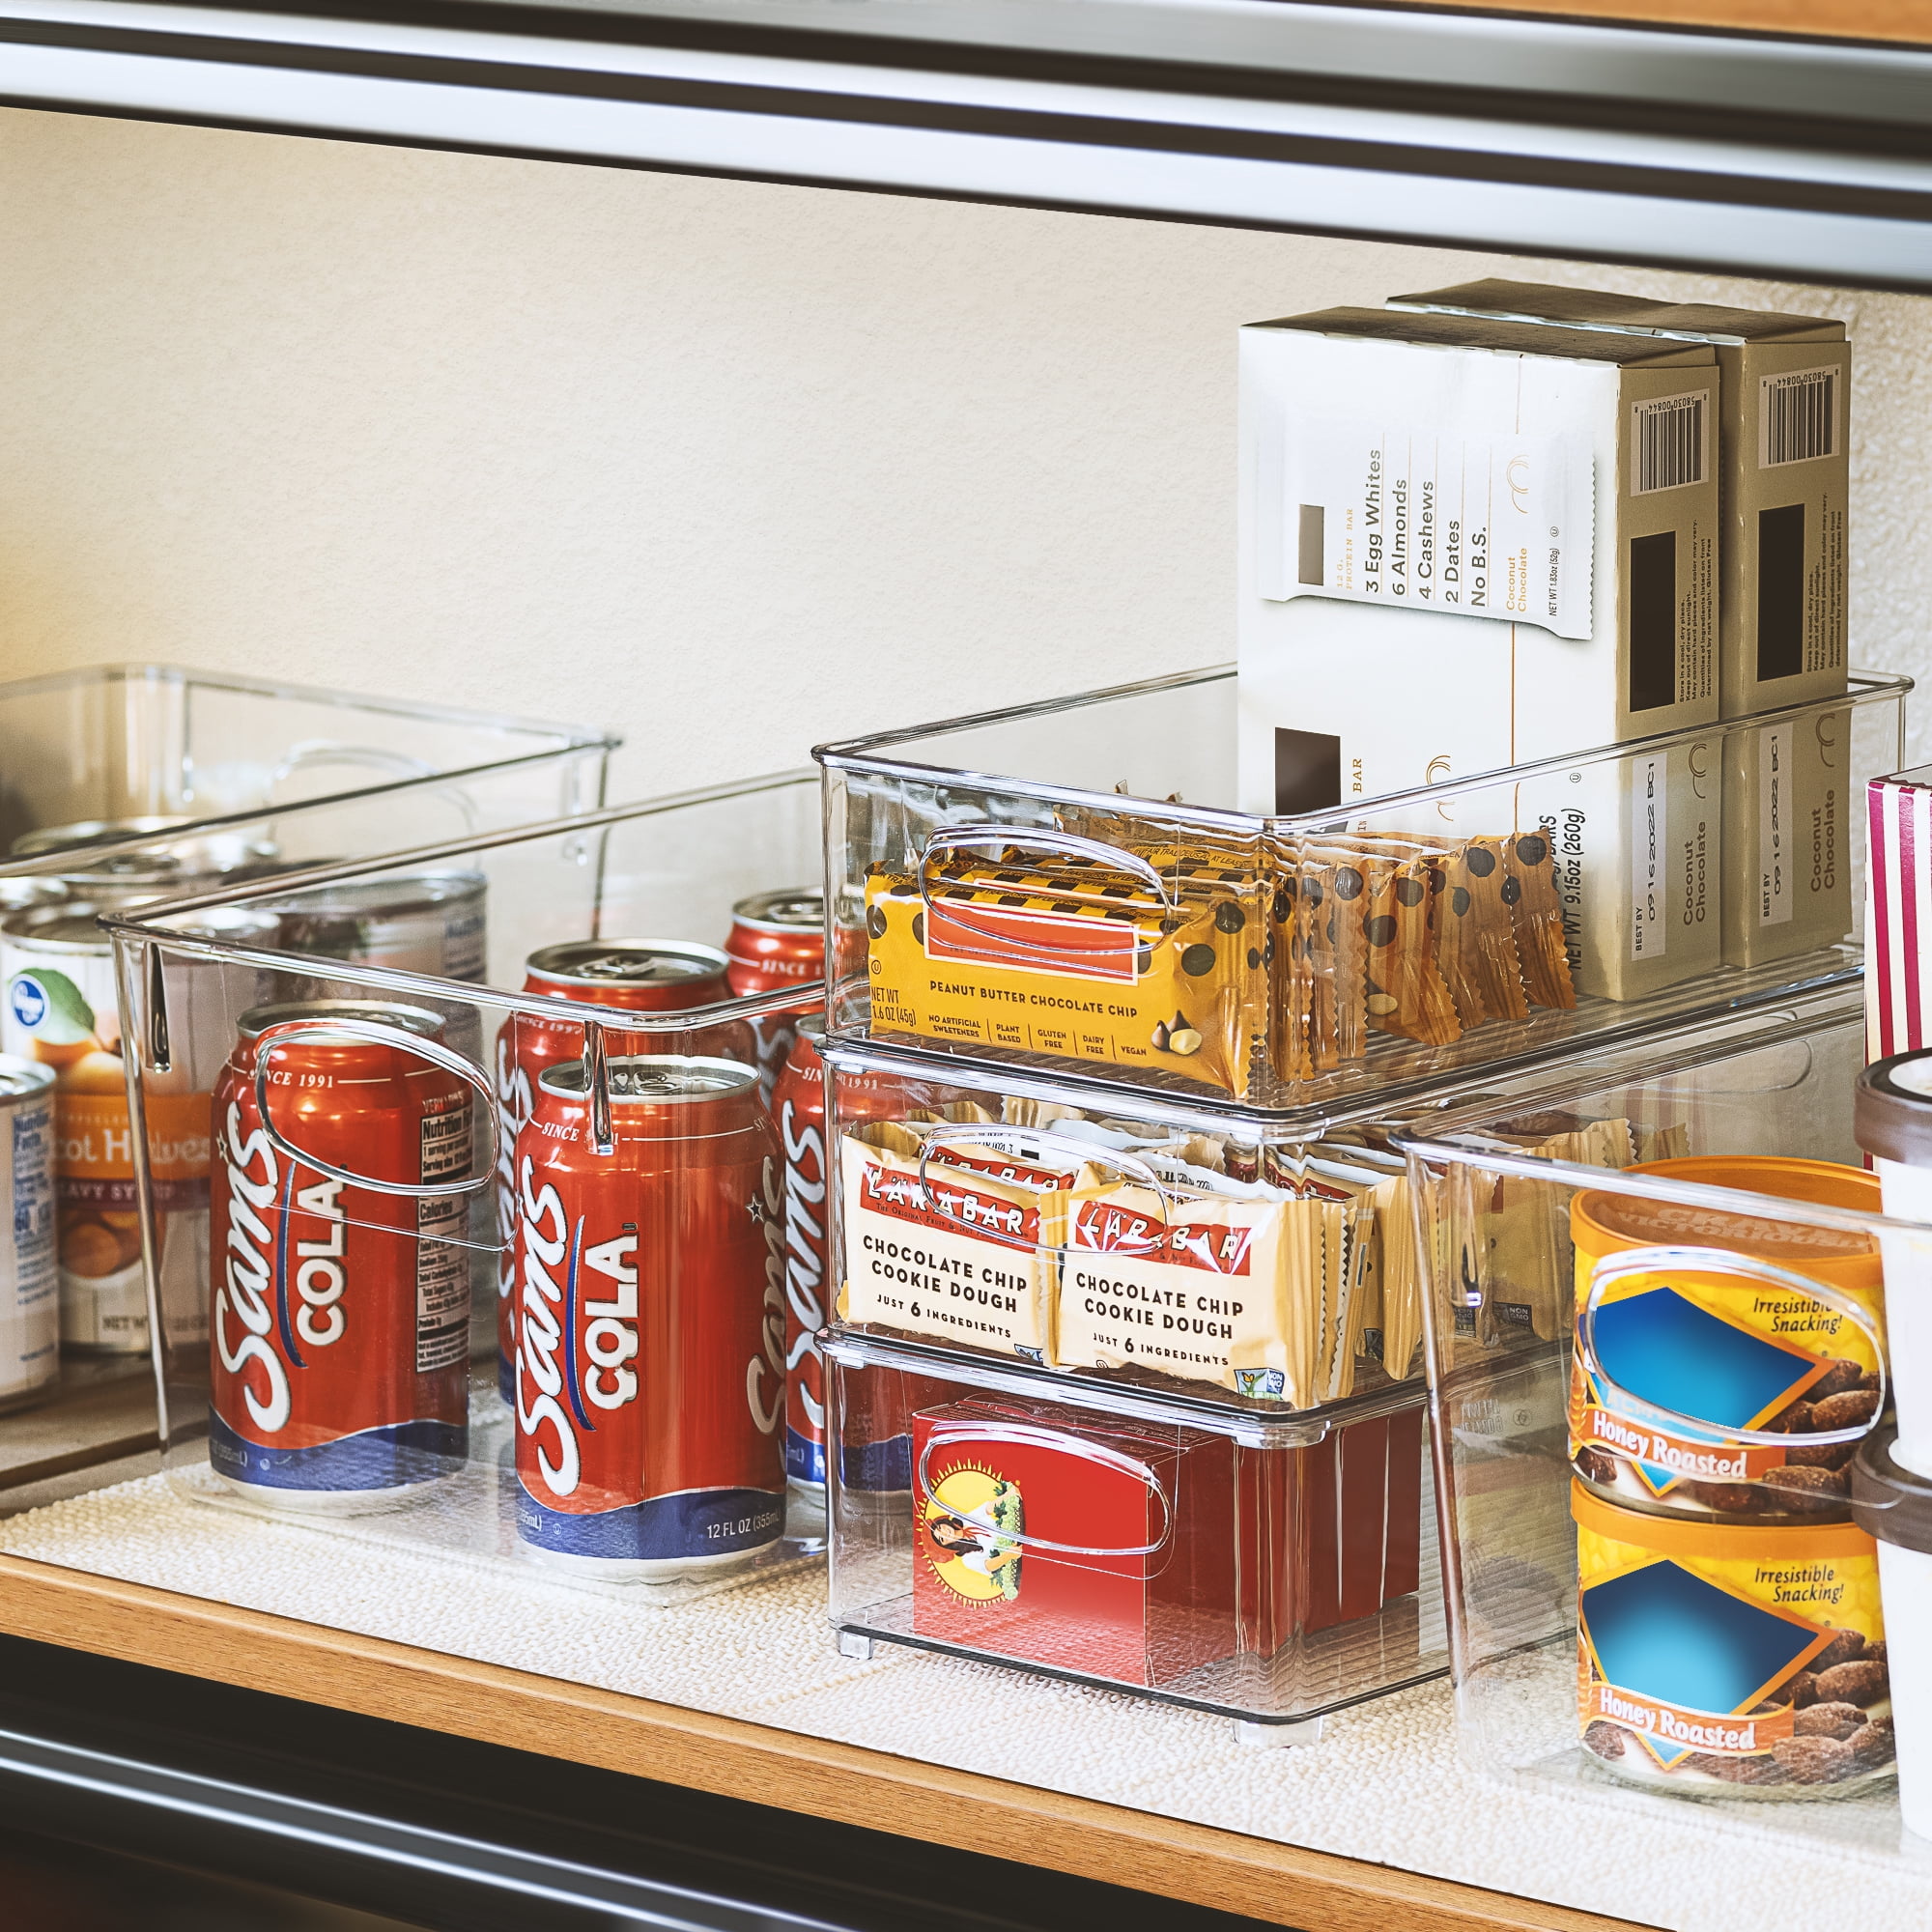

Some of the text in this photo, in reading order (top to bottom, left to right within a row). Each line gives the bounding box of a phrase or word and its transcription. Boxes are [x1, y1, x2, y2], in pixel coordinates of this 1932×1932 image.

[1365, 449, 1383, 593] 3 Egg Whites
[1391, 479, 1406, 595] 6 Almonds
[1418, 481, 1434, 599] 4 Cashews
[1445, 520, 1460, 603] 2 Dates
[1471, 526, 1487, 607] No B.S.
[1549, 548, 1560, 565] (52g)
[1519, 548, 1527, 612] Chocolate
[1549, 587, 1557, 600] WT
[1548, 602, 1557, 616] NET
[1352, 758, 1362, 793] BAR
[1561, 808, 1585, 856] (260g)
[1647, 804, 1656, 861] 2022
[1824, 789, 1835, 890] Chocolate
[1810, 808, 1822, 893] Coconut
[1563, 859, 1581, 904] 9.15oz
[1683, 839, 1693, 925] Coconut
[1695, 821, 1706, 923] Chocolate
[1764, 873, 1771, 890] BY
[1562, 908, 1581, 935] WT
[1636, 907, 1642, 923] BY
[1647, 894, 1656, 922] 09
[871, 986, 899, 1005] NET WT
[929, 980, 1137, 1017] PEANUT BUTTER CHOCOLATE CHIP
[872, 1005, 916, 1027] 1.6 OZ (45g)
[942, 1016, 981, 1028] ARTIFICIAL
[996, 1024, 1019, 1034] PLANT
[933, 1025, 980, 1037] SWEETENERS
[997, 1034, 1021, 1043] BASED
[1037, 1029, 1066, 1039] GLUTEN
[1044, 1039, 1063, 1049] FREE
[1082, 1035, 1105, 1045] DAIRY
[1086, 1045, 1104, 1055] FREE
[1121, 1045, 1147, 1056] VEGAN
[247, 1068, 333, 1088] SNCE 1991
[423, 1115, 462, 1140] Nutrition
[541, 1122, 580, 1142] SINCE
[423, 1159, 442, 1172] Serving
[420, 1200, 452, 1220] Calories
[296, 1177, 348, 1347] COLA
[864, 1235, 973, 1278] CHOCOLATE
[981, 1268, 1027, 1292] CHIP
[871, 1260, 1017, 1313] COOKIE DOUGH
[1076, 1272, 1243, 1317] CHOCOLATE CHIP
[583, 1235, 639, 1410] COLA
[877, 1294, 1011, 1338] JUST 6 INGREDIENTS
[1085, 1298, 1233, 1339] COOKIE DOUGH
[1771, 1315, 1842, 1334] Snacking!
[1094, 1333, 1229, 1366] JUST 6 INGREDIENTS
[1594, 1410, 1747, 1478] Honey Roasted
[706, 1523, 720, 1539] 12
[723, 1521, 735, 1537] FL
[738, 1519, 751, 1534] OZ
[1754, 1564, 1834, 1584] Irresistible
[1774, 1584, 1845, 1605] Snacking!
[1601, 1689, 1755, 1750] Honey Roasted
